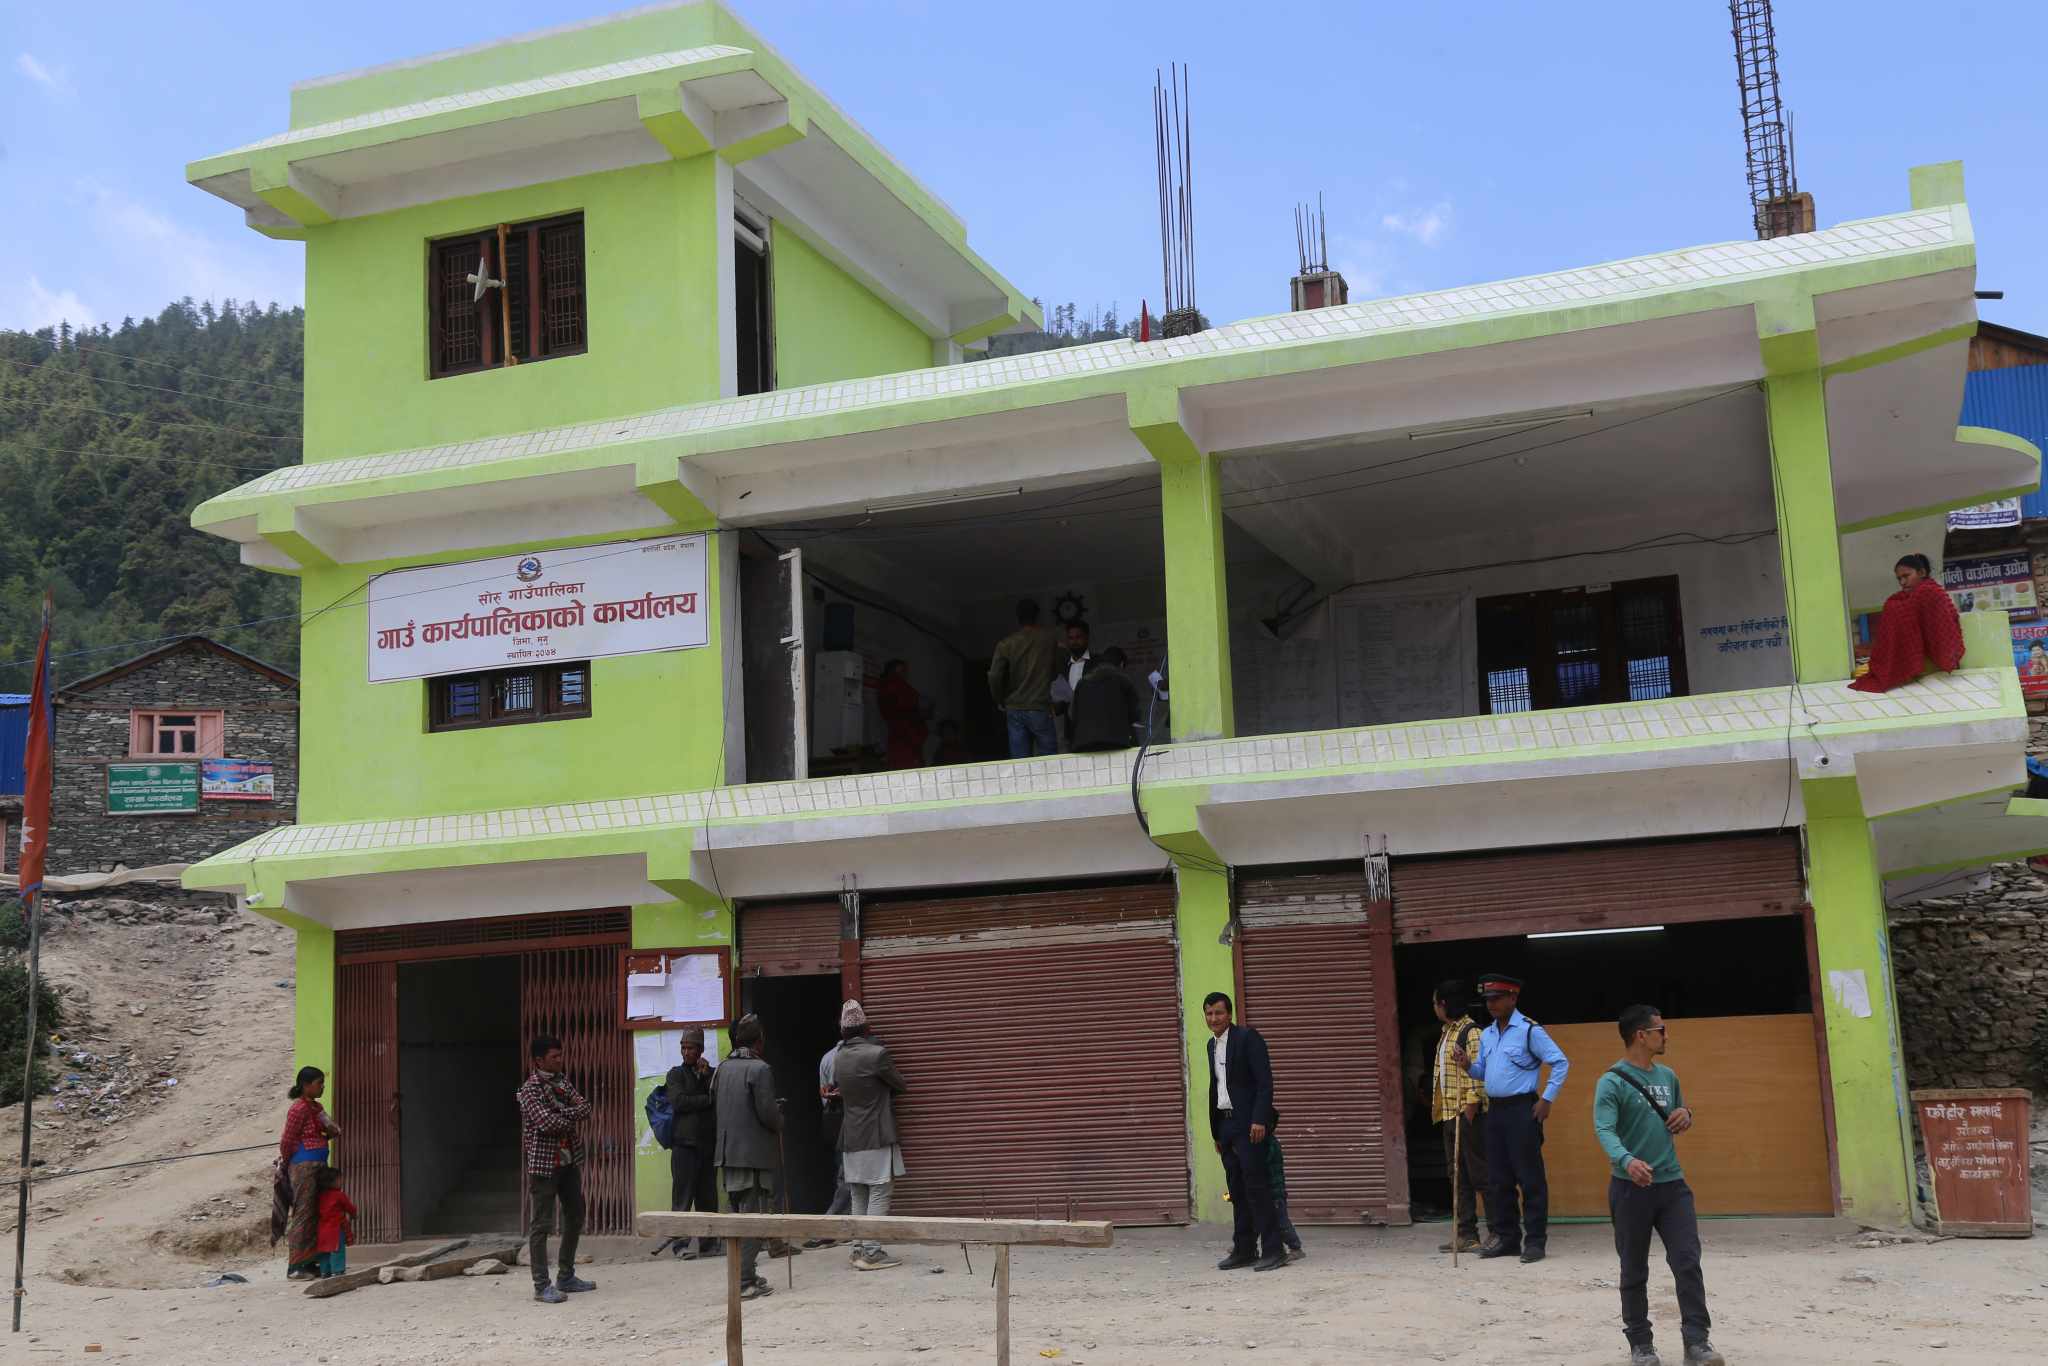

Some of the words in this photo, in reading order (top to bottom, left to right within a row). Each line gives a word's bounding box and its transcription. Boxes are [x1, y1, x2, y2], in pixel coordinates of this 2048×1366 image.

[508, 581, 586, 602] गाउँपालिका
[377, 619, 415, 651] गाउँ
[421, 600, 587, 644] कार्यपालिकाको
[593, 591, 698, 624] कार्यालय
[1642, 1084, 1671, 1096] IKE
